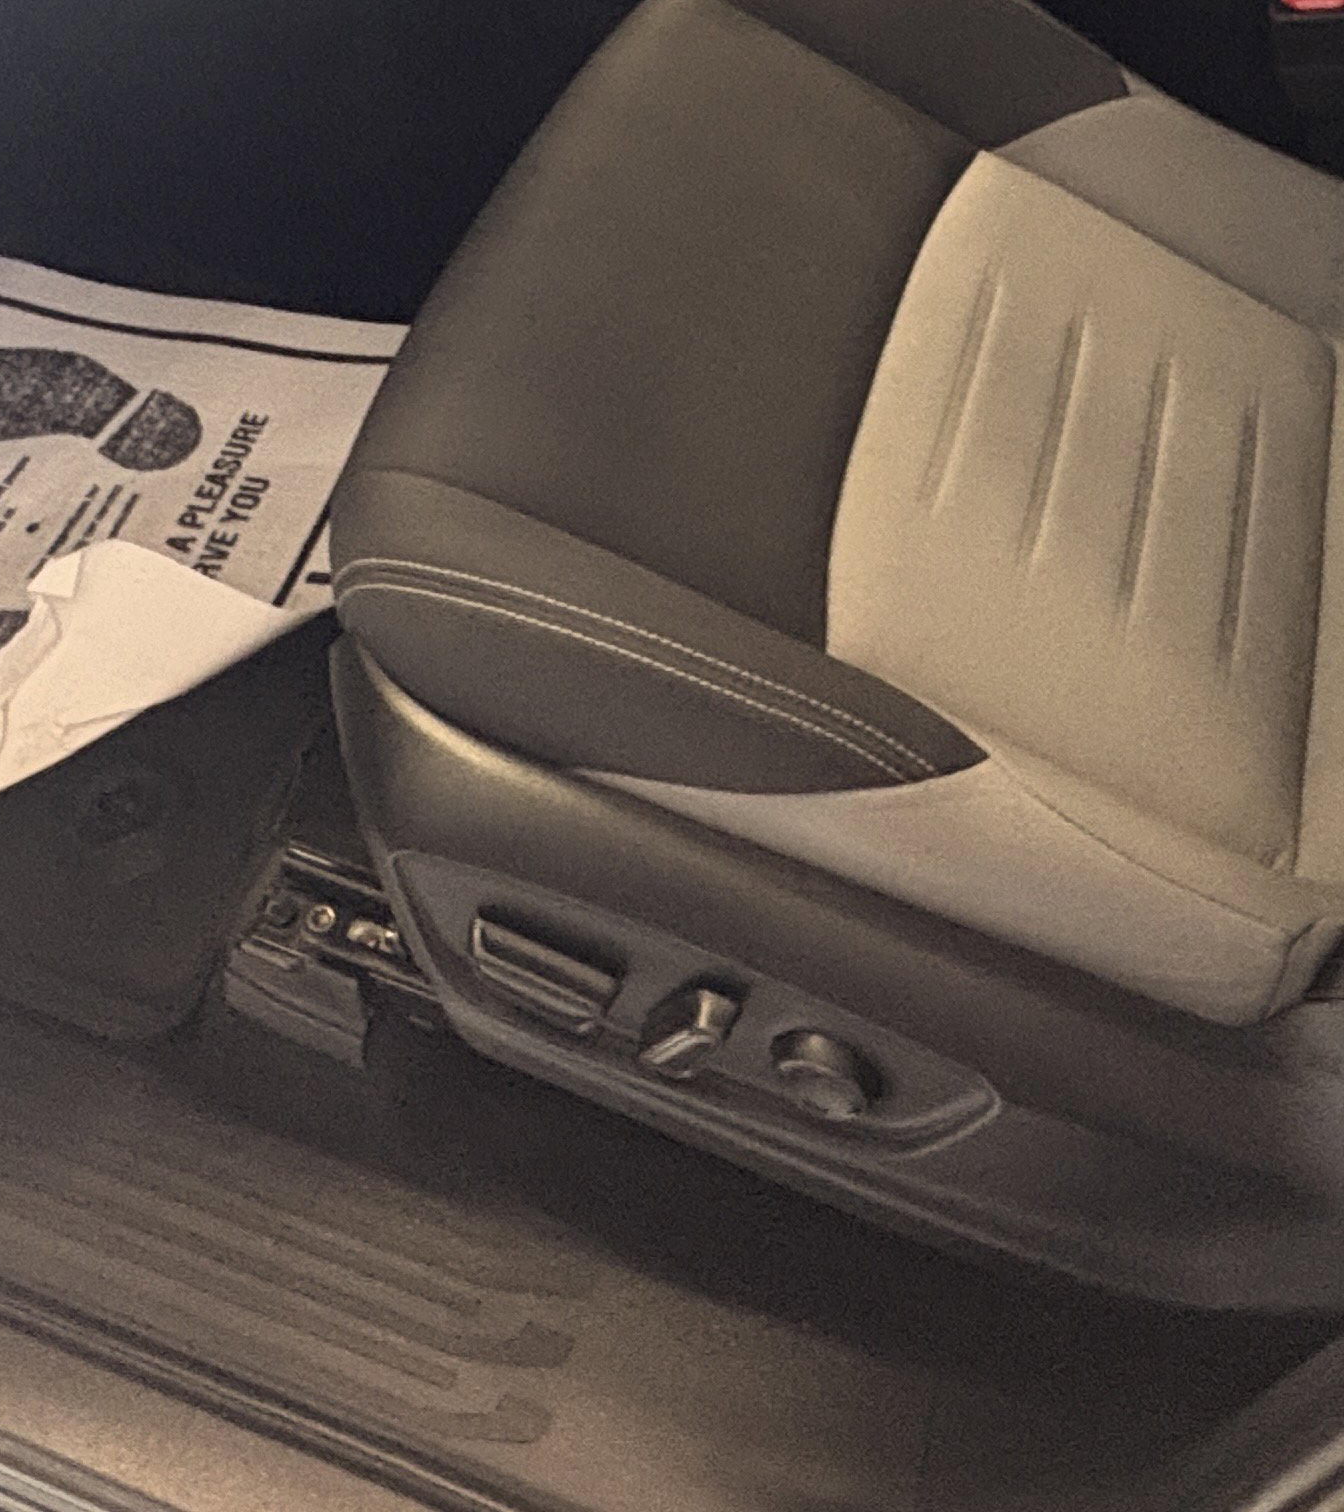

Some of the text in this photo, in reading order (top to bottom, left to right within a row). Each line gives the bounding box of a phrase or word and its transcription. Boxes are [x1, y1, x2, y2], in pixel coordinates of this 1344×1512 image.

[165, 409, 270, 554] A PLEASURE
[218, 476, 271, 523] YOU
